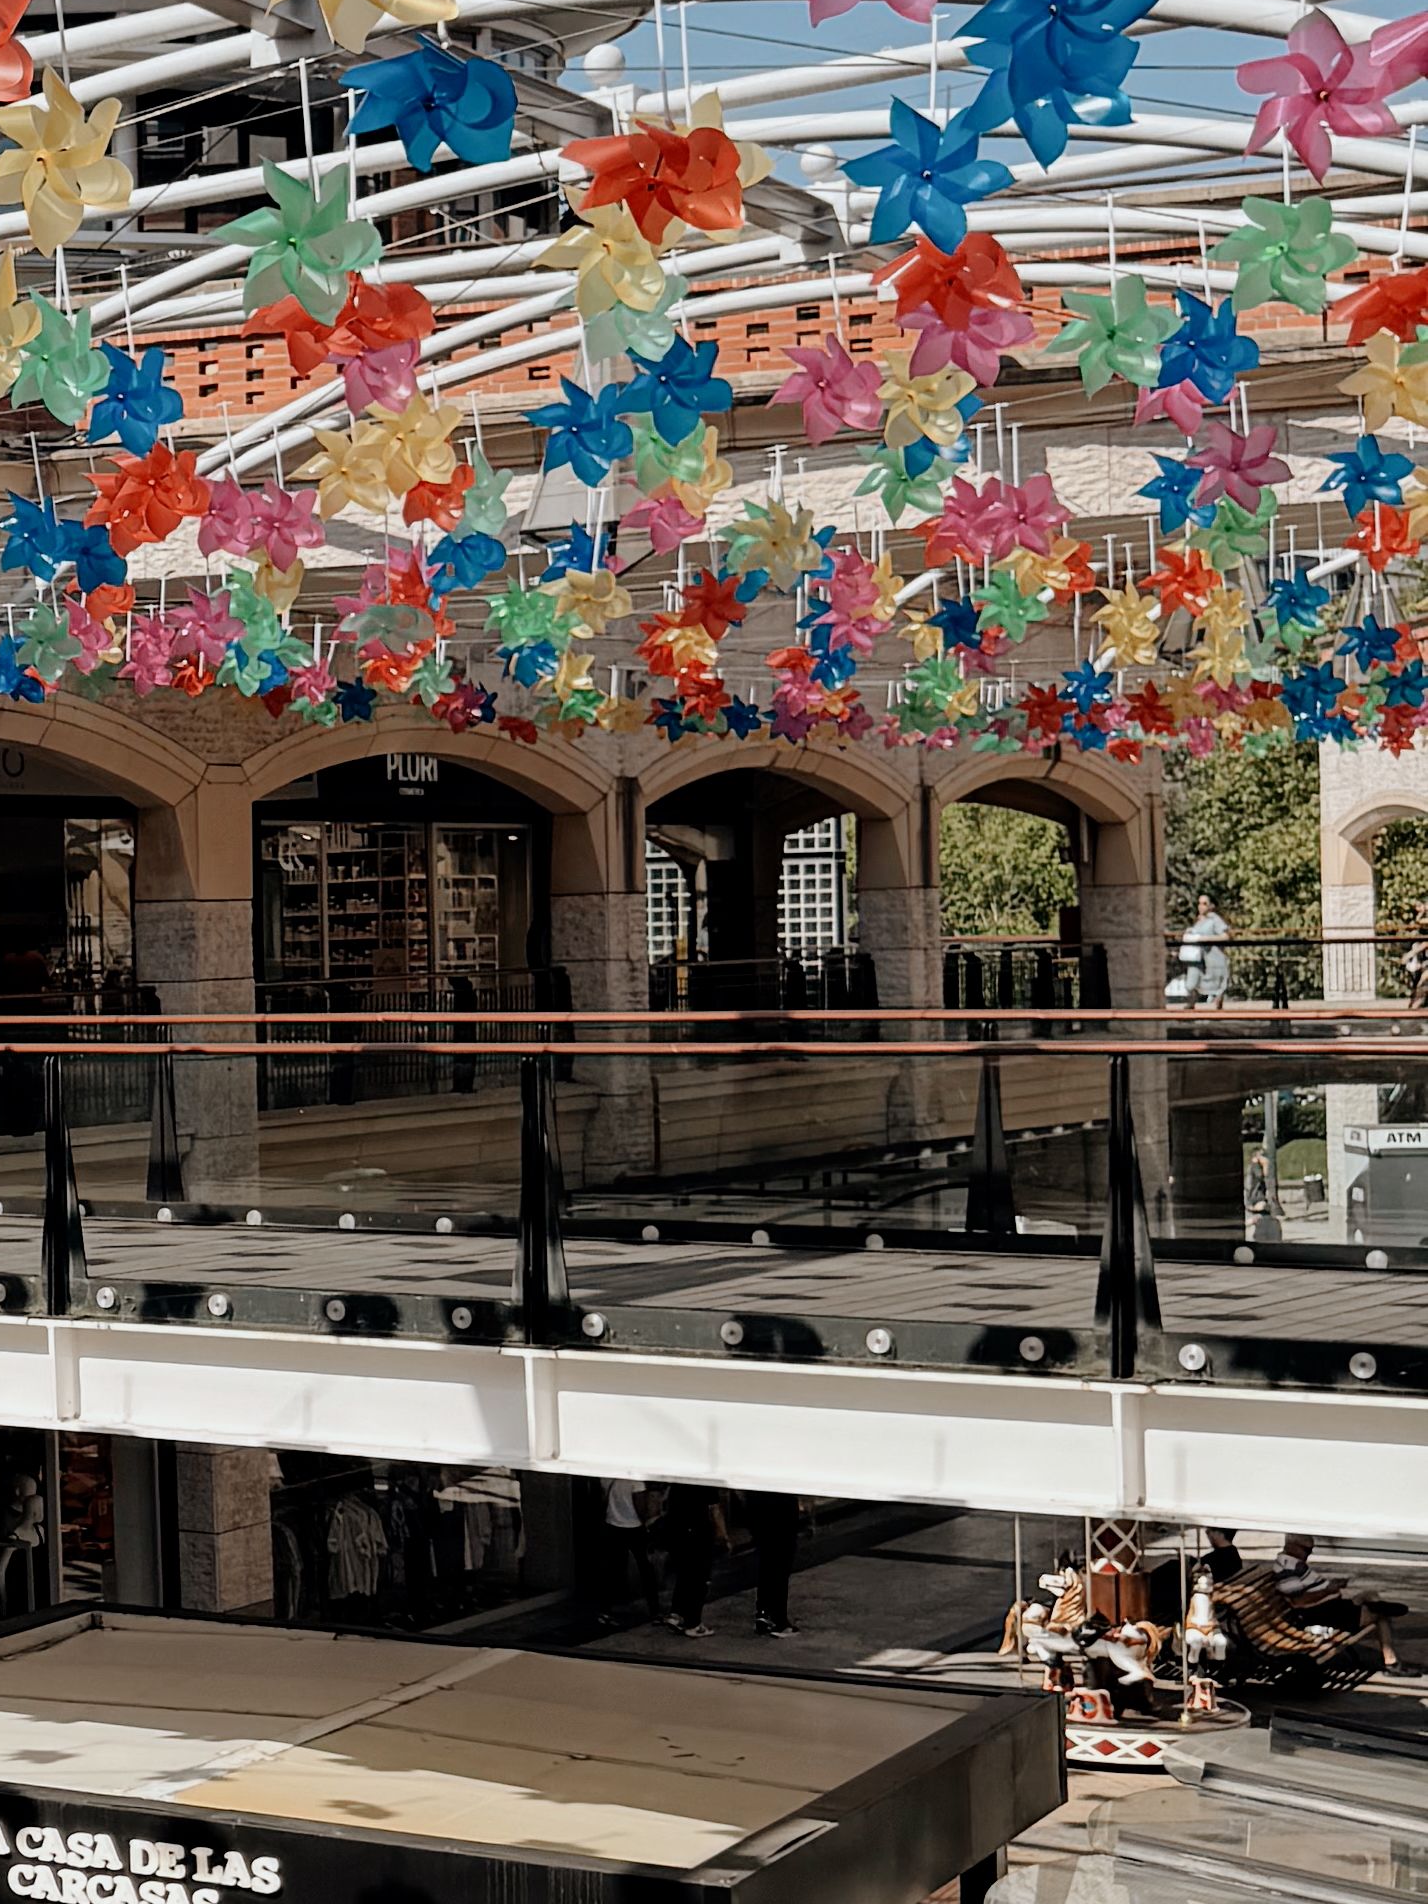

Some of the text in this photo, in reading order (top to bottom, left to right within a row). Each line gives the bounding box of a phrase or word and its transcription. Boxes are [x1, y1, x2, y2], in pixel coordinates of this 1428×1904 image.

[1386, 1131, 1422, 1143] ATM
[15, 1826, 123, 1872] CASA
[128, 1838, 187, 1880] DE
[191, 1846, 282, 1895] LAS
